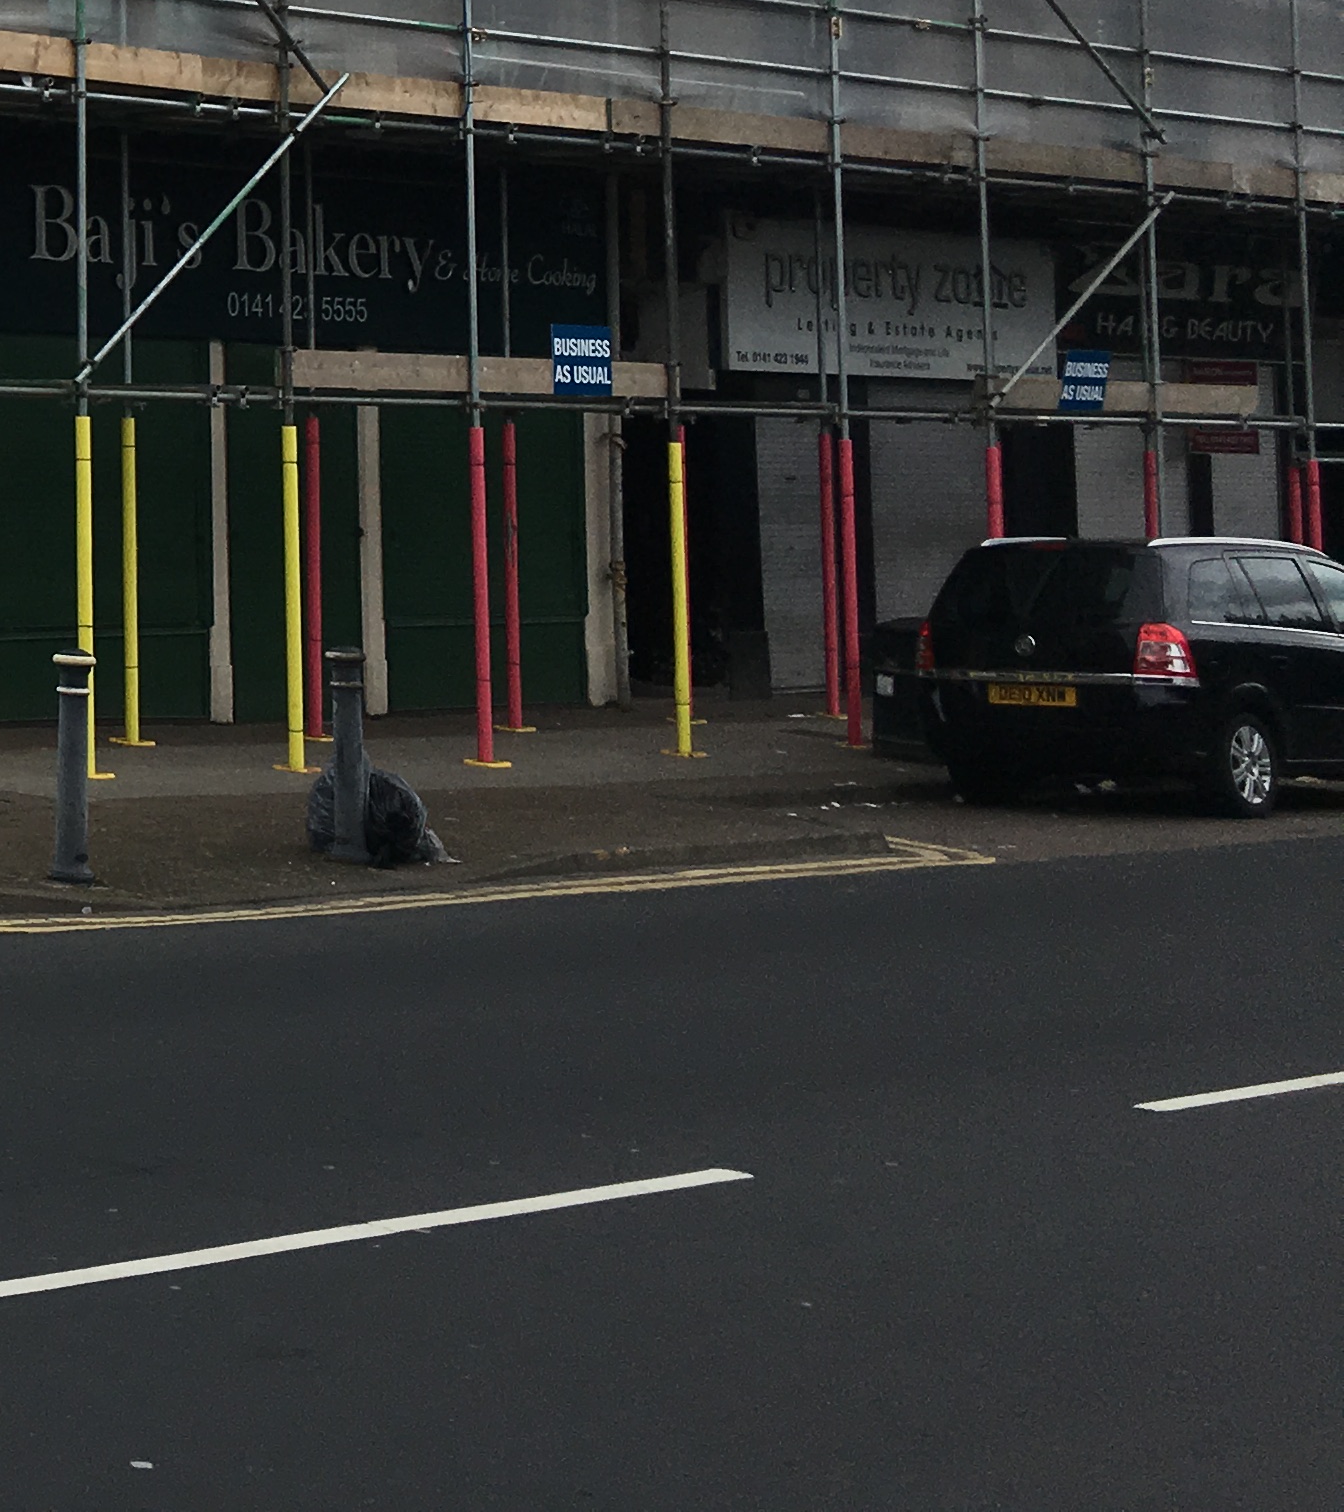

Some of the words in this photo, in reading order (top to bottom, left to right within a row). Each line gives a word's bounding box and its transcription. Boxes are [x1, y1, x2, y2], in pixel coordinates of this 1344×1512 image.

[27, 184, 202, 291] Baji's
[231, 198, 435, 294] Bakery
[434, 249, 458, 281] &
[527, 254, 597, 295] Cooking
[227, 292, 273, 318] 0141
[321, 296, 368, 323] 5555
[796, 316, 858, 338] Letig
[867, 320, 876, 336] &
[885, 321, 936, 338] Estate
[944, 324, 999, 343] Agens
[1187, 317, 1274, 343] BEAUTY
[553, 337, 611, 358] BUSINESS
[555, 364, 572, 384] AS
[573, 365, 612, 385] USUAL
[1065, 361, 1110, 378] BUSINESS
[1060, 384, 1076, 401] AS
[1076, 385, 1104, 401] USUAL
